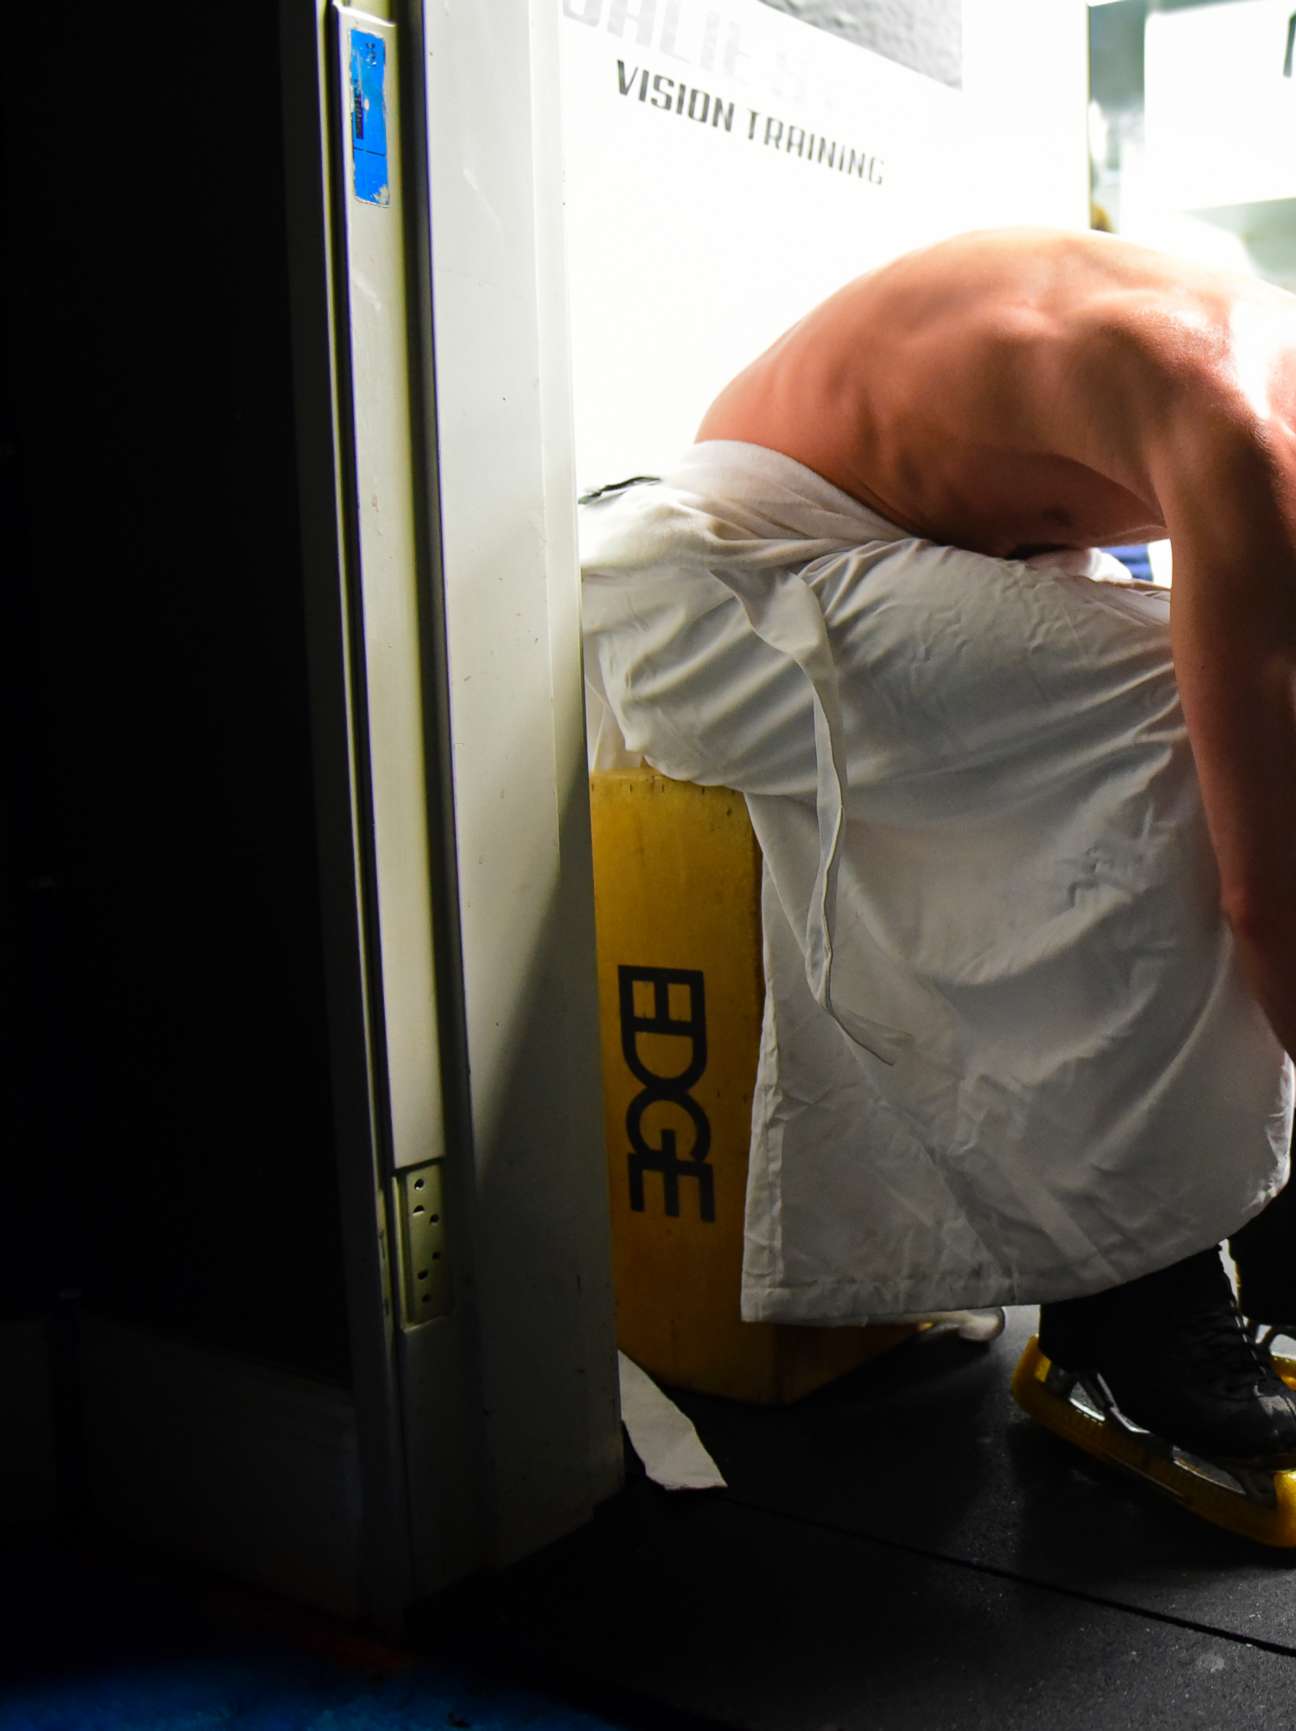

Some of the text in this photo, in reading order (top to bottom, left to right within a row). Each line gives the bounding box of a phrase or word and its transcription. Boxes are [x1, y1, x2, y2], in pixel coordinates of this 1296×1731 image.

[616, 58, 886, 186] VISION TRAINING
[618, 965, 716, 1224] EDGE
